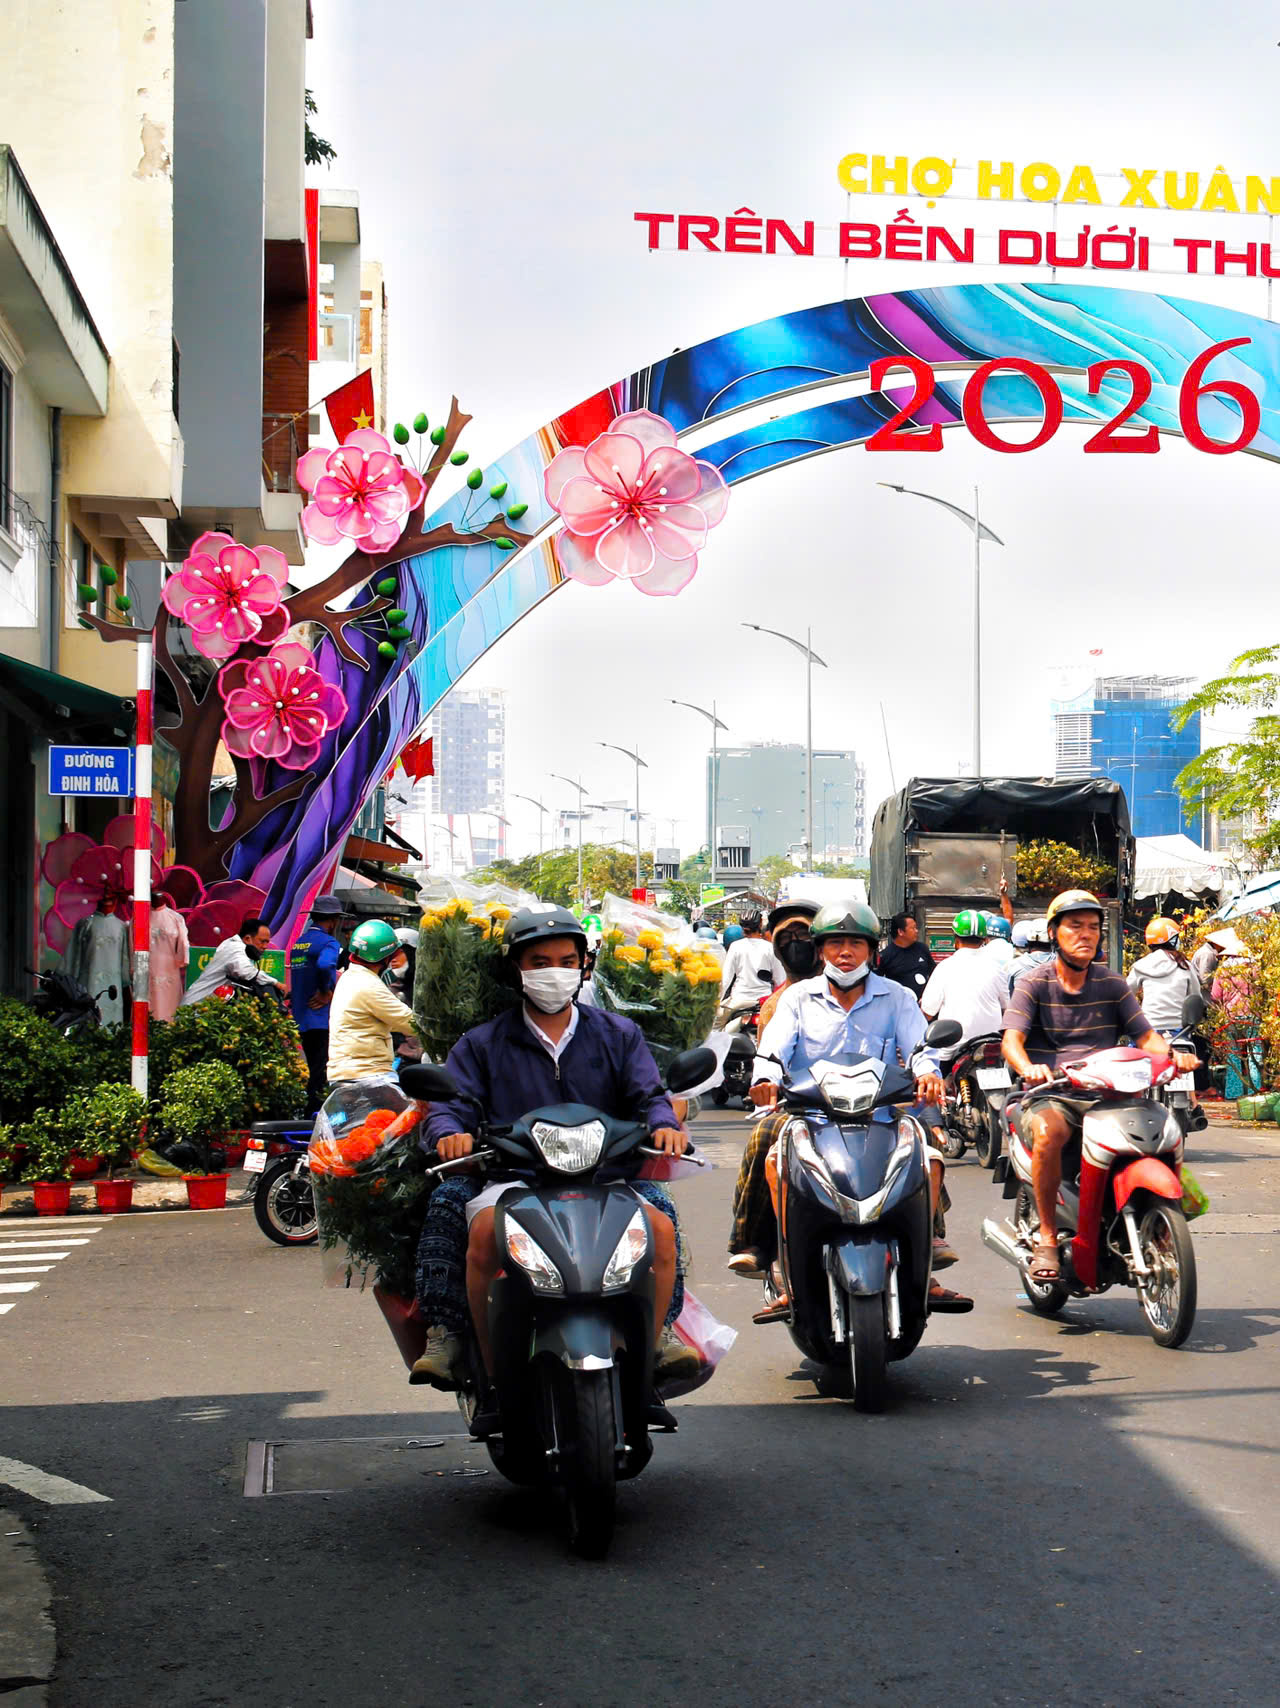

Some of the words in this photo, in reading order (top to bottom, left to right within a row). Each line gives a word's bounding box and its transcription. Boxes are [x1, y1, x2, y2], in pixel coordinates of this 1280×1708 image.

[838, 153, 957, 209] CHỢ
[977, 160, 1103, 205] HOA
[634, 206, 815, 257] TRÊN
[839, 208, 974, 264] BẾN
[999, 224, 1150, 272] DƯỚI
[864, 336, 1262, 455] 2026
[61, 775, 91, 792] ĐINH
[95, 773, 119, 792] HÒA
[64, 751, 115, 769] ĐƯỜNG
